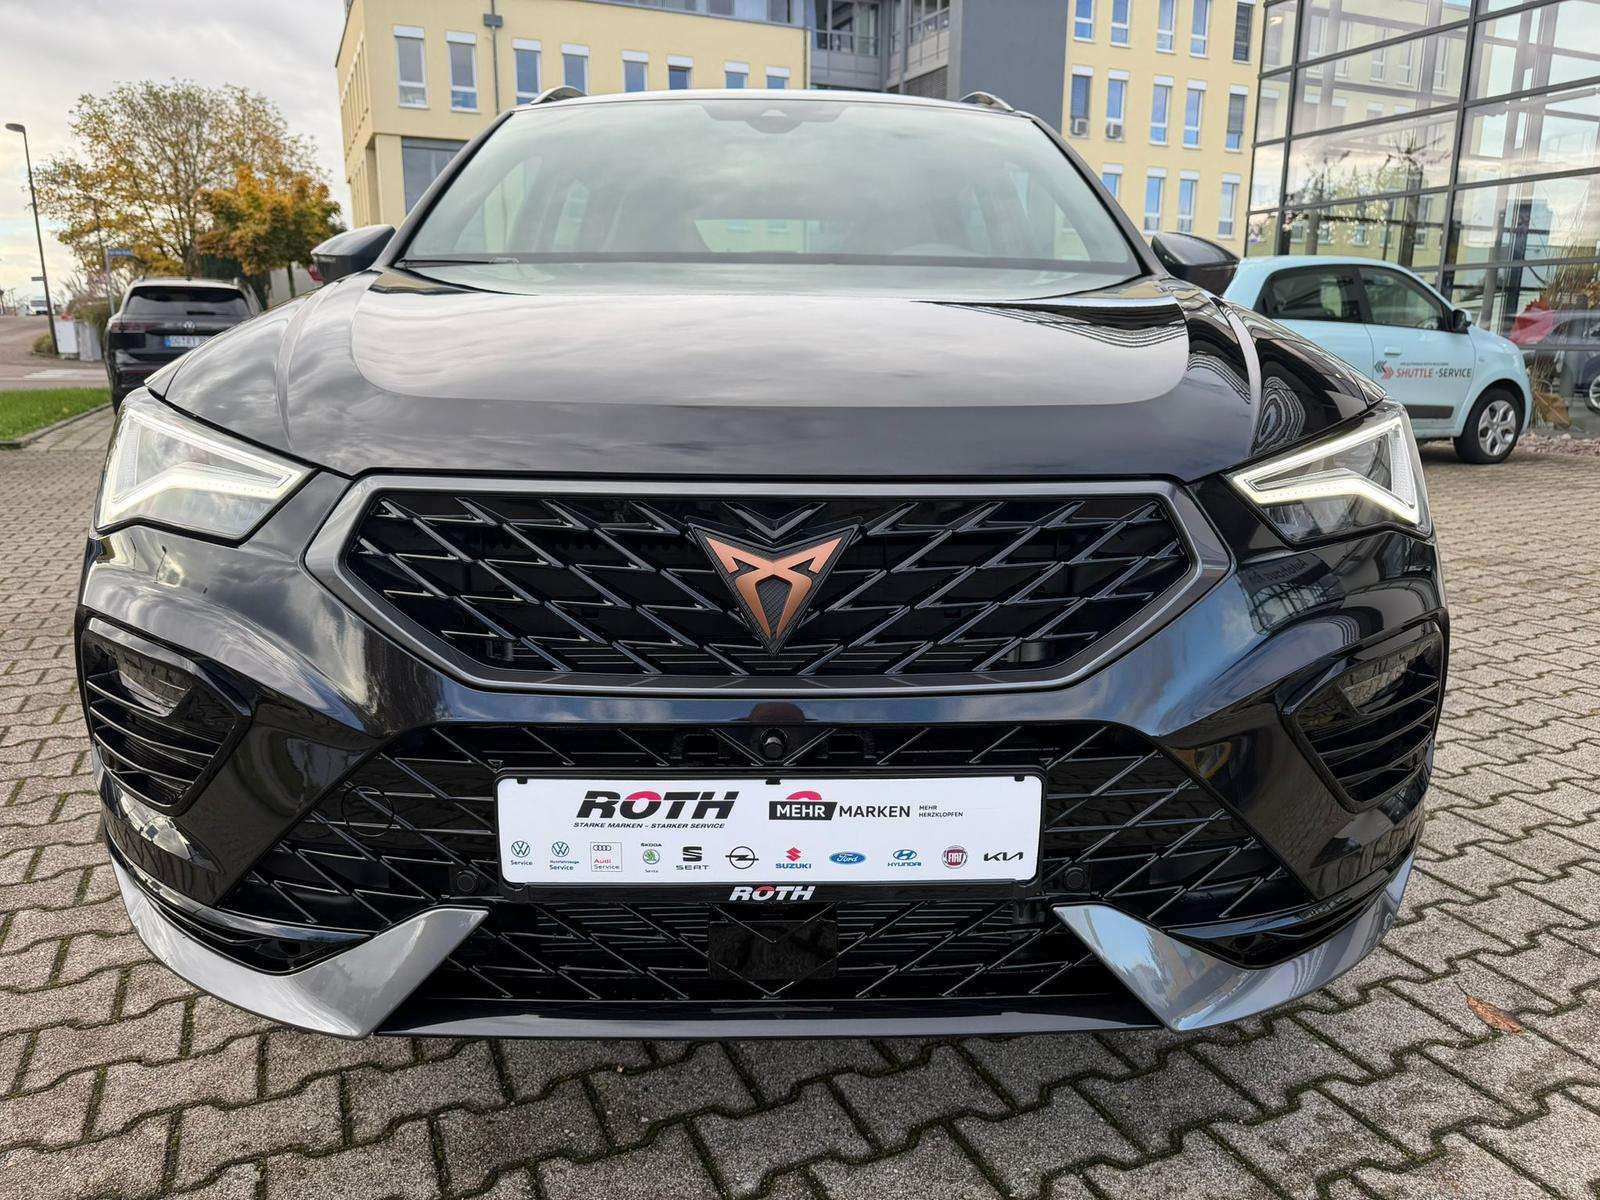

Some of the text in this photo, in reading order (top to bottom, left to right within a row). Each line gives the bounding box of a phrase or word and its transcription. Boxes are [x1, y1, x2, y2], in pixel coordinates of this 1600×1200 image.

[1395, 368, 1433, 378] SHUTTLE
[575, 790, 740, 820] ROTH
[776, 804, 911, 818] MEHR MARKEN
[836, 853, 858, 863] Ford
[947, 853, 964, 863] FIAT
[728, 885, 816, 901] ROTH
